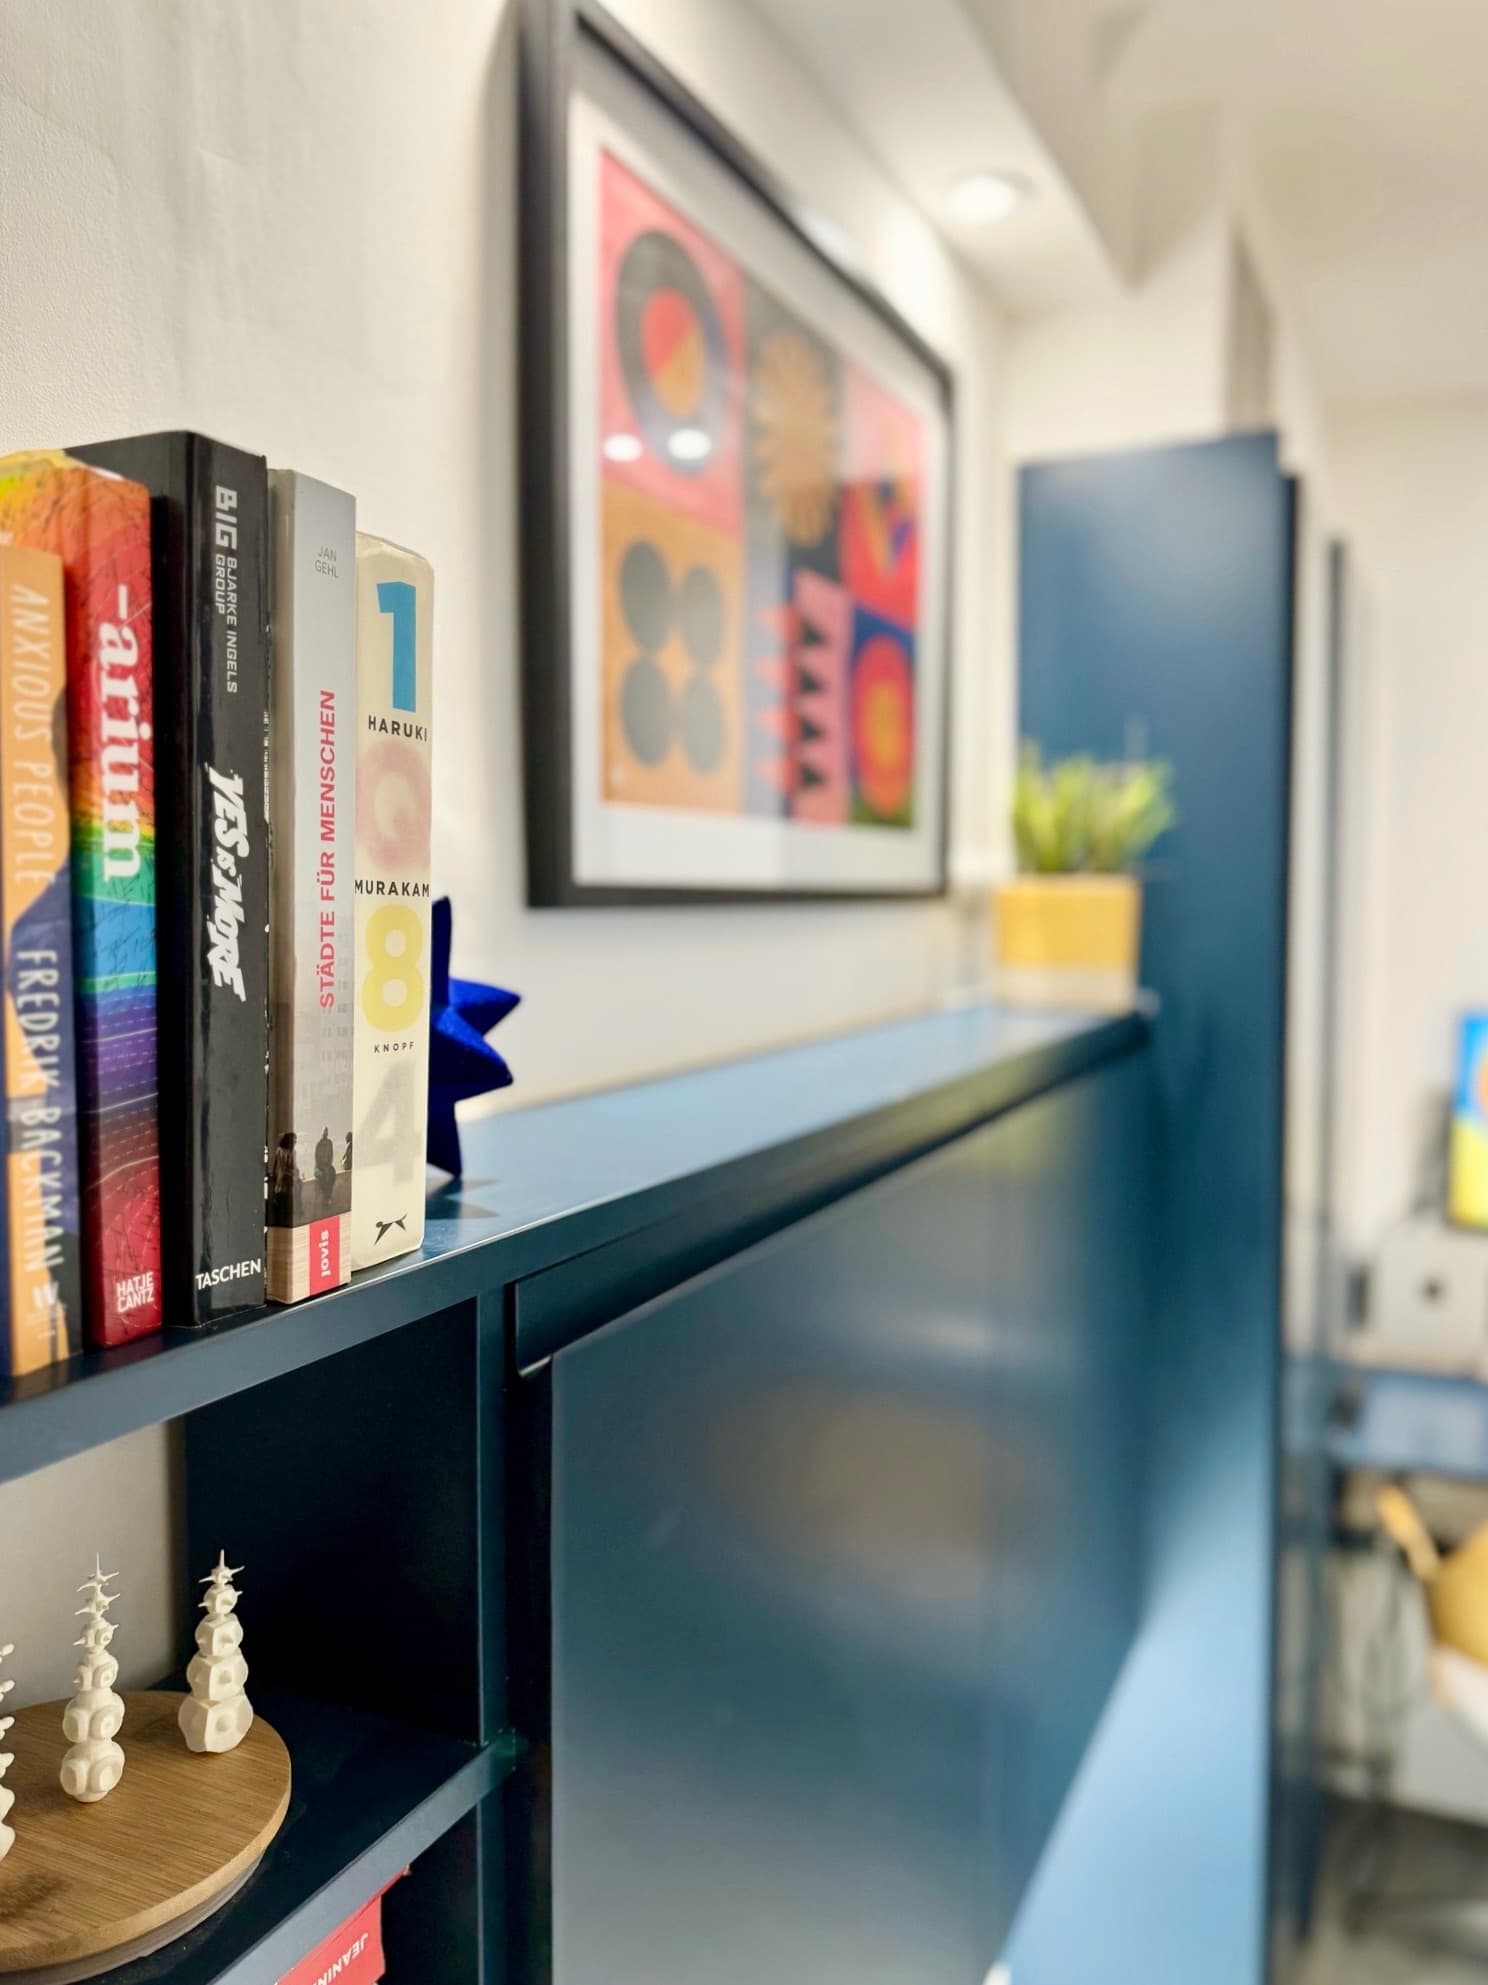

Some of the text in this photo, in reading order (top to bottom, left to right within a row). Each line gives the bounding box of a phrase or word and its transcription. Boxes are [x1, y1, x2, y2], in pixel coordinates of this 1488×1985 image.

[215, 484, 238, 550] BIG
[215, 553, 226, 615] GROUP
[314, 559, 340, 579] GEHL
[317, 545, 338, 562] JAN
[226, 557, 238, 693] BJARKE INGELS
[376, 581, 417, 713] 1
[10, 584, 56, 887] ANXIOUS PEOPLE
[368, 714, 428, 742] HARUKI
[204, 762, 250, 858] YES
[317, 690, 336, 1009] STÄDTE FÜR MENSCHEN
[361, 904, 423, 1033] 8
[16, 948, 60, 1090] FREDRIK
[374, 1041, 415, 1054] KNOPF
[354, 1059, 420, 1187] 4
[20, 1106, 64, 1273] BACKMAN
[116, 1271, 154, 1297] HATJE
[196, 1258, 262, 1290] TASCHEN
[318, 1229, 331, 1277] jovis
[117, 1283, 155, 1315] CANTZ
[313, 1932, 368, 1985] JEANIN
